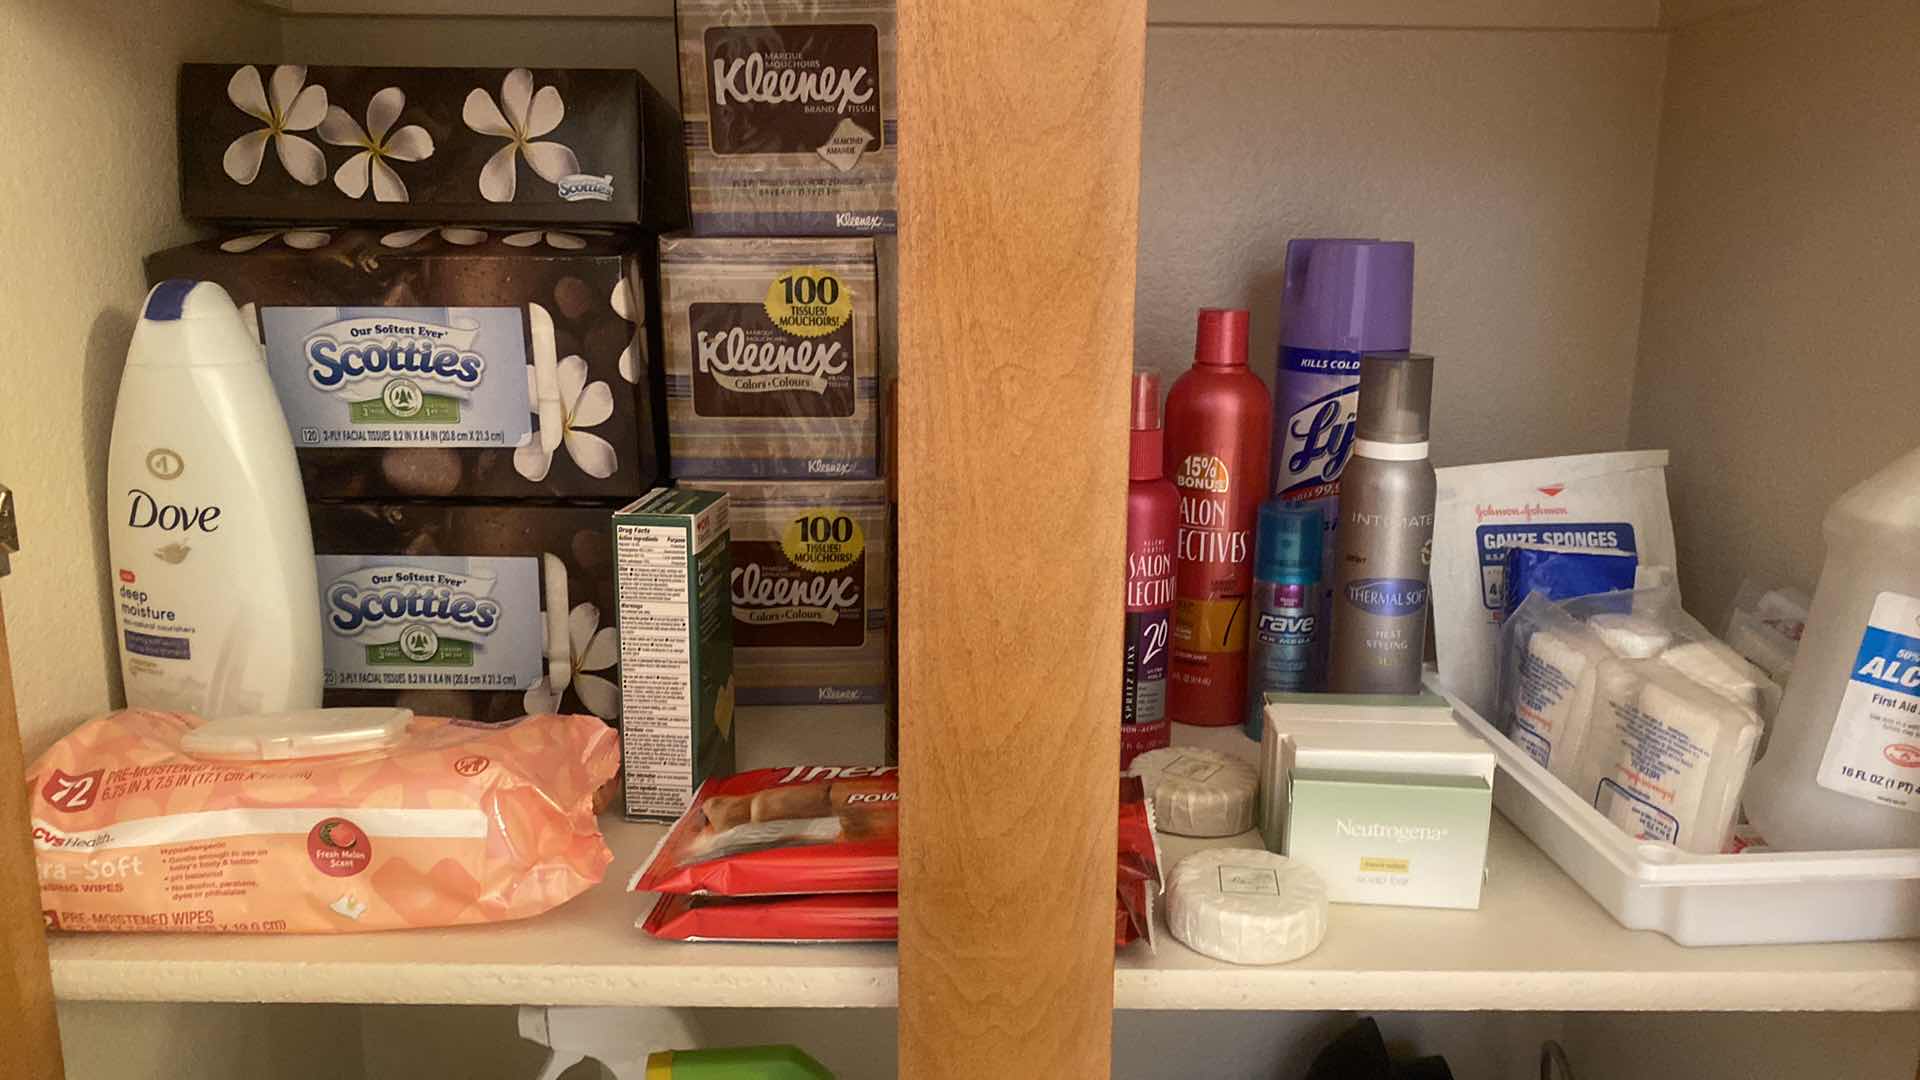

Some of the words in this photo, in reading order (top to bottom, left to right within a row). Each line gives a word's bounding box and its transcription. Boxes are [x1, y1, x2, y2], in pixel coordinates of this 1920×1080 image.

[714, 52, 874, 114] Kleenex
[804, 105, 835, 113] BRAND
[848, 104, 876, 112] TISSUE
[836, 212, 881, 229] Kleenex
[779, 275, 838, 305] 100
[792, 306, 827, 316] TISSUES!
[779, 316, 839, 327] MOUCHOIRS!
[350, 326, 372, 337] Our
[375, 324, 416, 336] Softest
[697, 327, 848, 381] Kleenex
[311, 340, 481, 386] Scotties
[1301, 359, 1328, 369] KILLS
[735, 380, 766, 390] Colors
[772, 378, 810, 388] Colours
[304, 431, 317, 440] 120
[808, 459, 851, 475] Kleenex
[1184, 455, 1216, 478] 15%
[1178, 475, 1227, 490] BONUS
[128, 489, 221, 532] Dove
[795, 516, 853, 543] 100
[1543, 531, 1618, 547] SPONGES
[807, 544, 841, 552] TISSUES!
[794, 553, 852, 562] MOUCHOIRS!
[1129, 552, 1171, 580] SALON
[372, 573, 393, 585] Our
[120, 585, 148, 604] deep
[1350, 587, 1402, 607] THERMAL
[122, 603, 175, 621] moisture
[331, 586, 497, 630] Scotties
[750, 612, 780, 621] Colors
[785, 610, 821, 619] Colours
[1259, 615, 1314, 632] rave
[1143, 618, 1168, 664] 20
[1858, 656, 1920, 687] ALC
[819, 687, 860, 700] Kleenex
[1872, 694, 1897, 708] First
[1899, 700, 1918, 713] Aid
[102, 785, 125, 800] 6.75
[127, 780, 140, 793] IN
[142, 779, 151, 791] X
[155, 777, 174, 790] 7.5
[176, 775, 190, 787] IN
[1842, 766, 1854, 777] 16
[1855, 770, 1867, 781] FL
[1870, 774, 1884, 785] OZ
[1885, 779, 1895, 789] (1
[1897, 781, 1914, 795] PT)
[51, 777, 93, 807] 72
[1336, 818, 1441, 843] Neutrogena
[316, 849, 339, 859] Fresh
[341, 851, 365, 860] Melon
[330, 858, 354, 868] Scent
[37, 855, 143, 880] ra-Soft
[80, 882, 124, 893] WIPES
[62, 911, 168, 926] PRE-MOISTENED
[171, 910, 214, 926] WIPES
